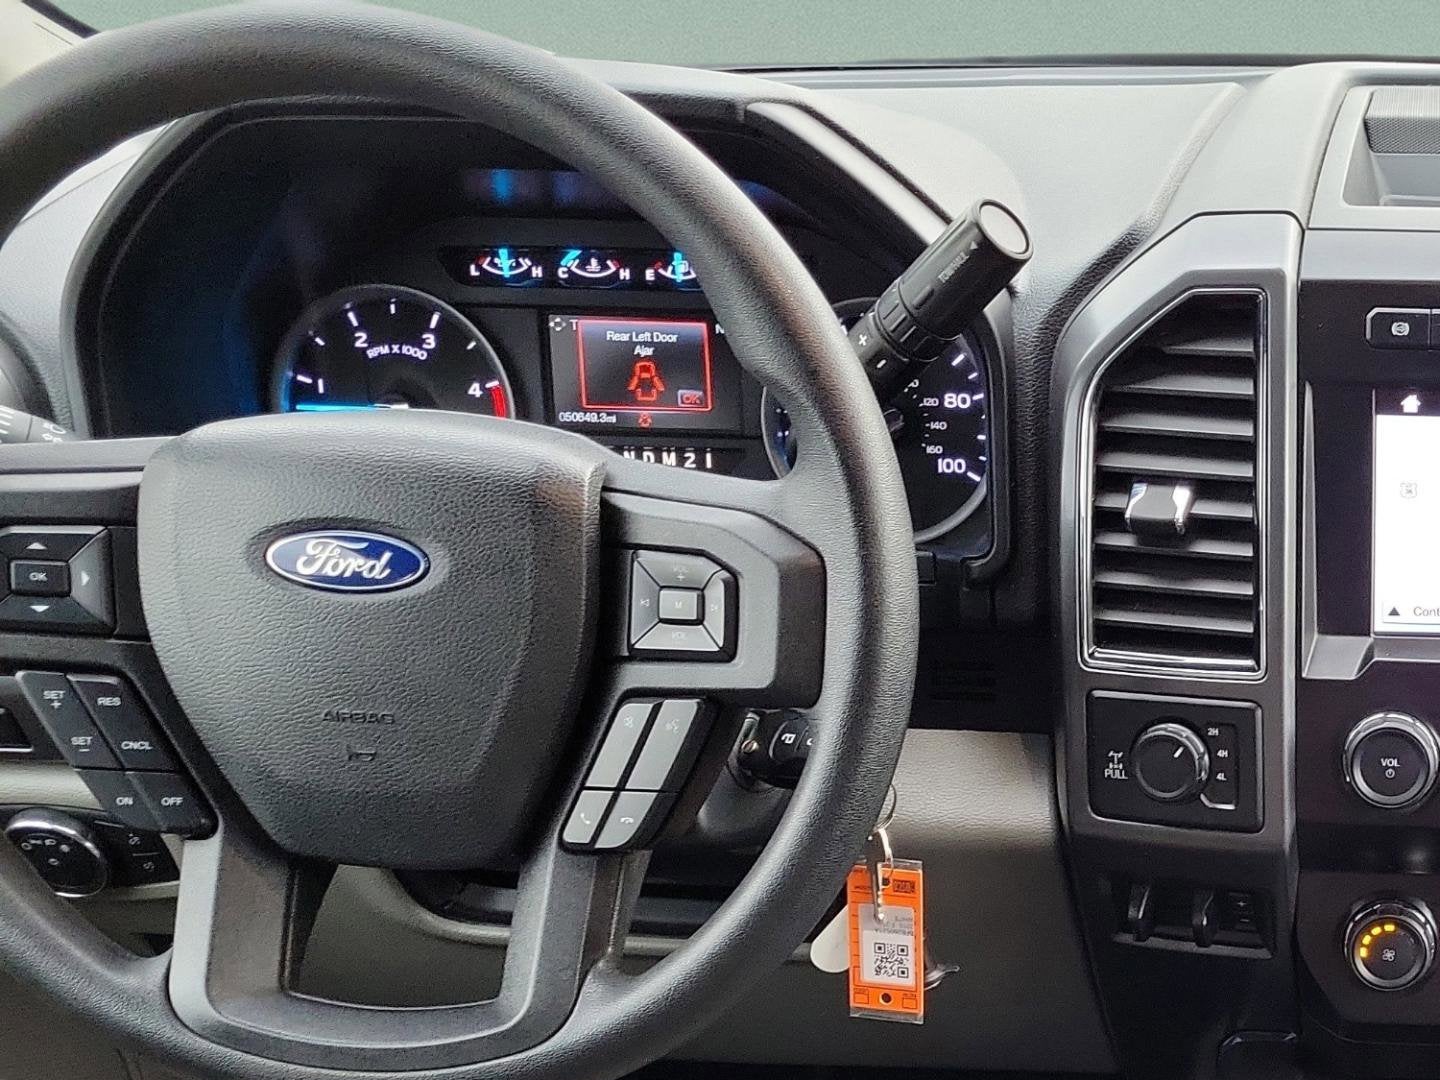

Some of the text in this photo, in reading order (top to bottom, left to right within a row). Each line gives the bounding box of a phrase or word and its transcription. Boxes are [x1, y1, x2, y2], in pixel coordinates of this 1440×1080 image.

[469, 264, 480, 276] L
[531, 266, 543, 278] H
[557, 267, 569, 279] C
[619, 268, 631, 280] H
[645, 269, 656, 281] E
[354, 332, 368, 348] 2
[422, 333, 436, 349] 3
[606, 330, 679, 343] Rear Left Door
[366, 344, 428, 360] RPM X 1000
[633, 344, 655, 358] Ajar
[317, 378, 325, 394] 1
[467, 382, 484, 398] 4
[682, 394, 701, 405] OK
[922, 397, 940, 407] 120
[943, 393, 972, 409] 80
[929, 421, 948, 430] 140
[926, 445, 943, 454] 160
[662, 451, 676, 466] M
[683, 452, 697, 468] 2
[705, 452, 713, 469] 1
[937, 458, 966, 474] 100
[296, 538, 393, 580] Ford
[28, 571, 48, 582] OK
[43, 690, 66, 700] SET
[97, 697, 122, 707] RES
[321, 709, 396, 725] AIRBAG
[1207, 728, 1219, 736] 2H
[70, 736, 93, 746] SET
[121, 741, 153, 751] CNCL
[1216, 750, 1229, 758] 4H
[1380, 758, 1401, 767] VOL
[1104, 769, 1128, 780] PULL
[1216, 773, 1227, 781] 4L
[116, 797, 134, 806] ON
[161, 797, 184, 806] OFF
